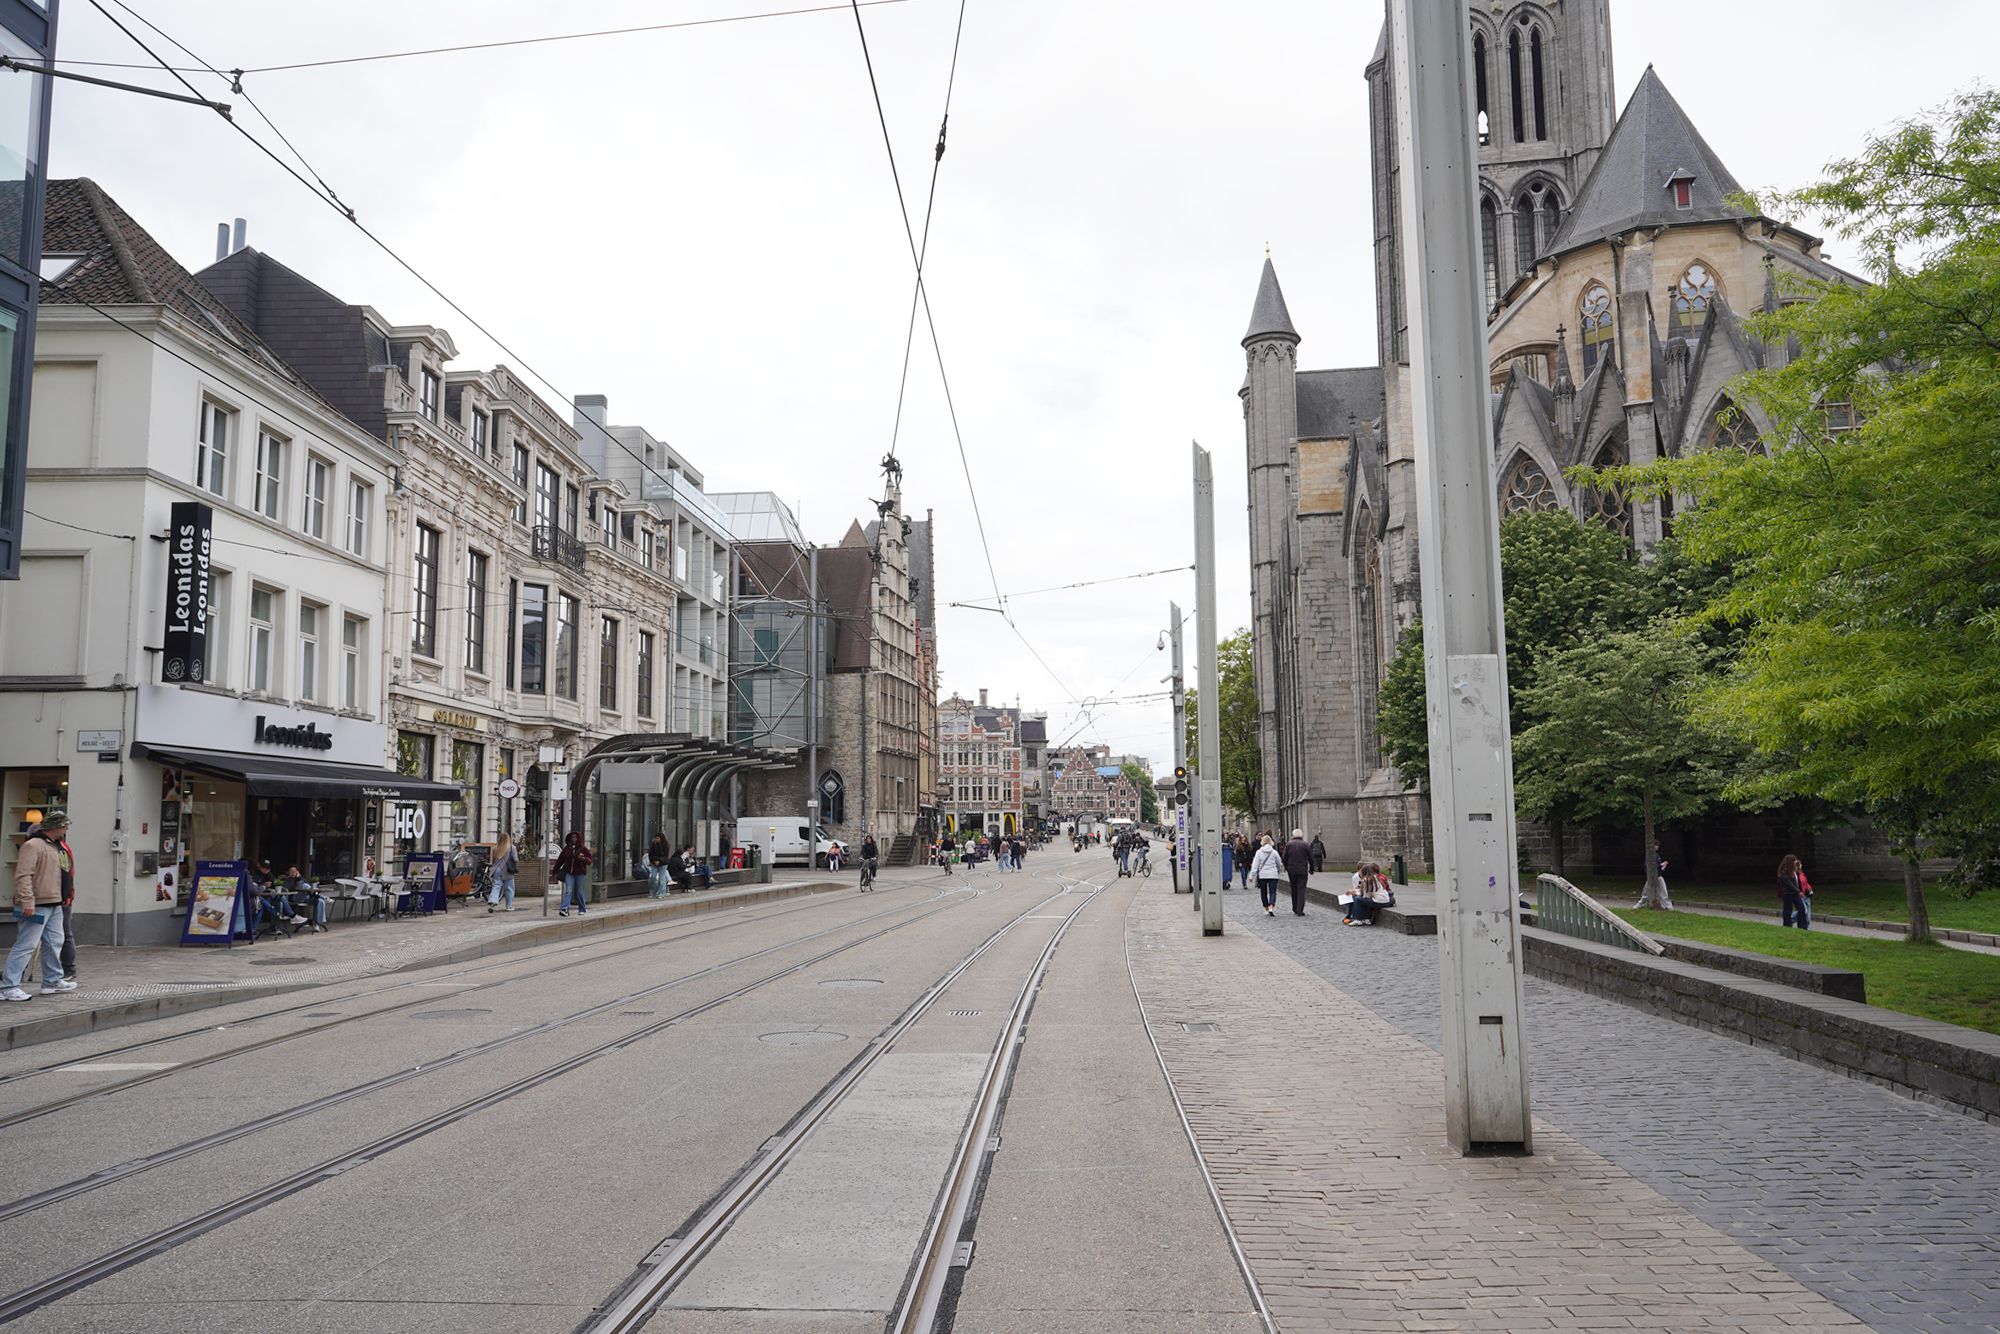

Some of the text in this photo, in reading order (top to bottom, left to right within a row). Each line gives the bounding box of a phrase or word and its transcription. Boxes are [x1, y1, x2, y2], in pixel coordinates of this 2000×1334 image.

[168, 524, 195, 633] Leonidas
[193, 528, 211, 636] Leonidas
[254, 715, 333, 750] Leonidas
[394, 808, 426, 839] HEO
